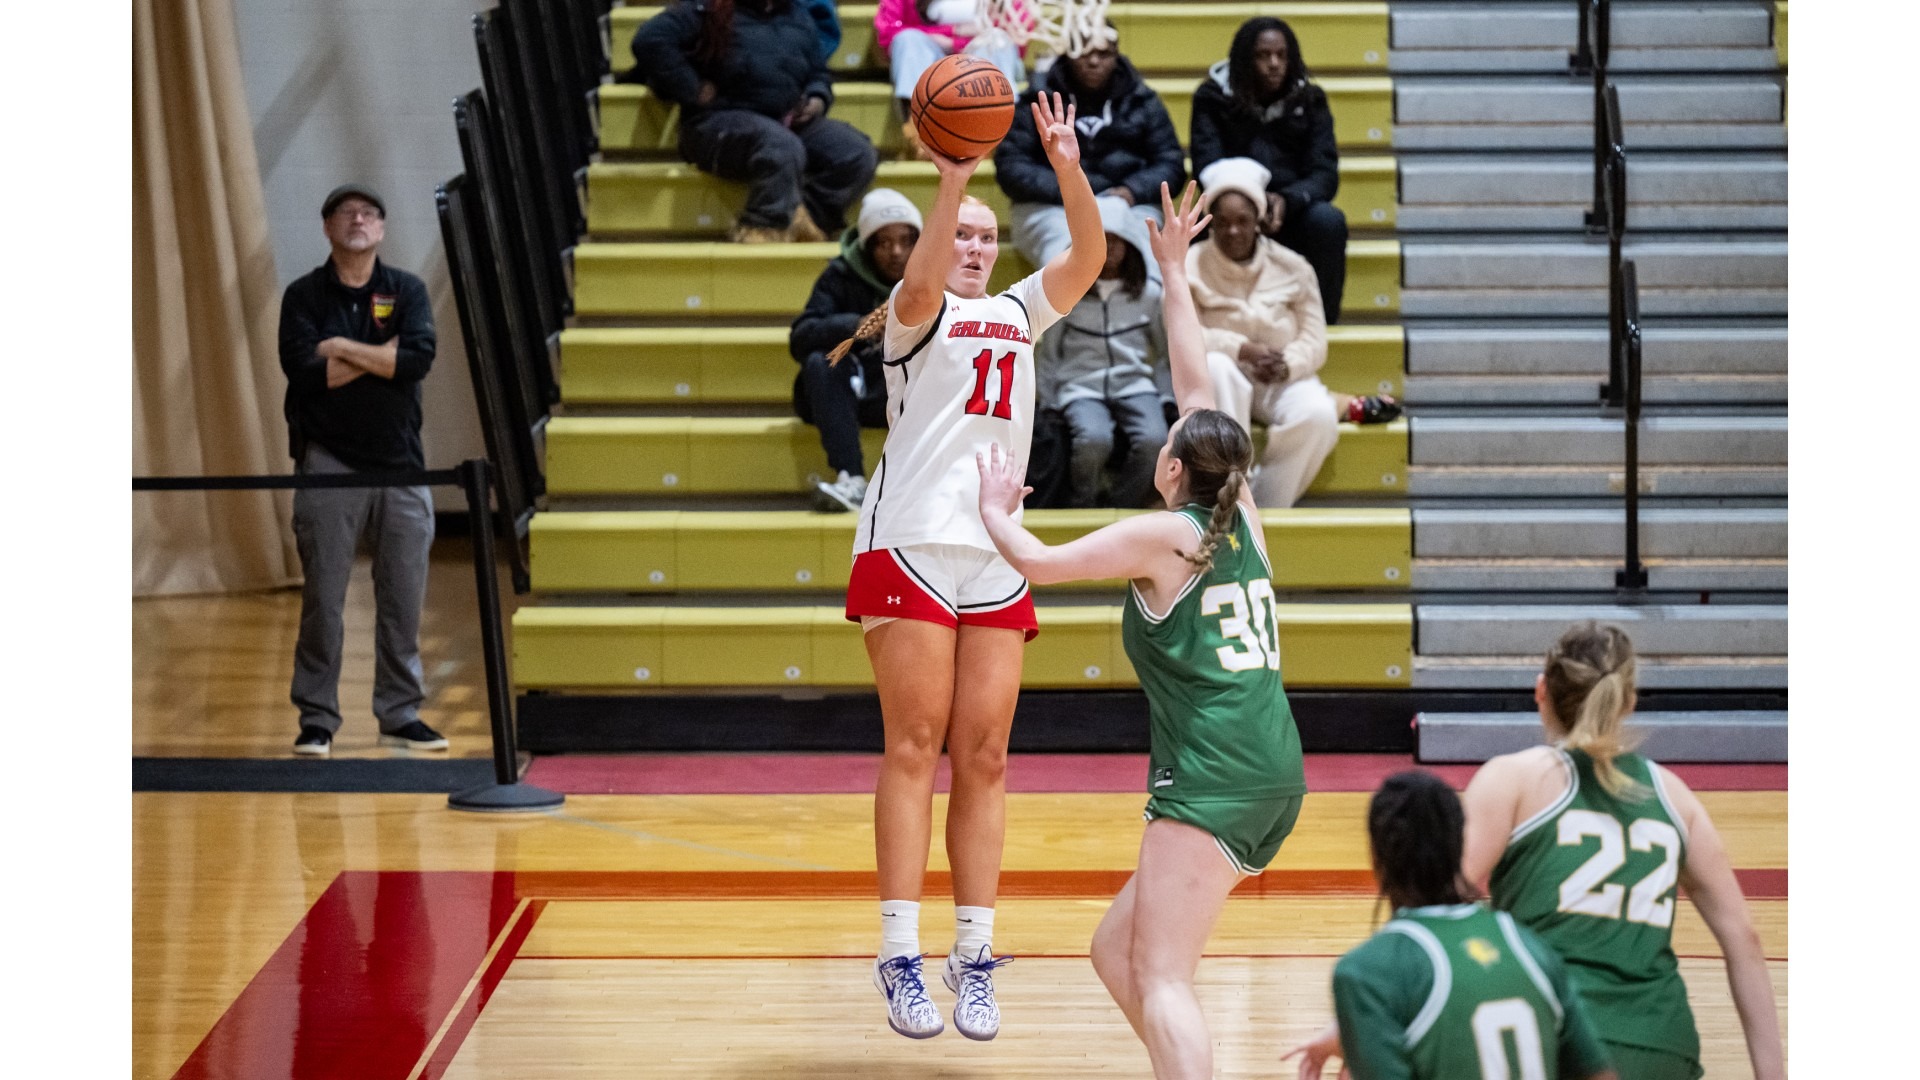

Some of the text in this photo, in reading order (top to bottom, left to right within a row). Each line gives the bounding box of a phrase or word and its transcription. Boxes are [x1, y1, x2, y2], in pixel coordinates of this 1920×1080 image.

[955, 76, 995, 97] ROCK
[965, 348, 1017, 421] 11
[1201, 578, 1280, 673] 30
[1556, 810, 1681, 928] 22
[1471, 998, 1547, 1080] 0
